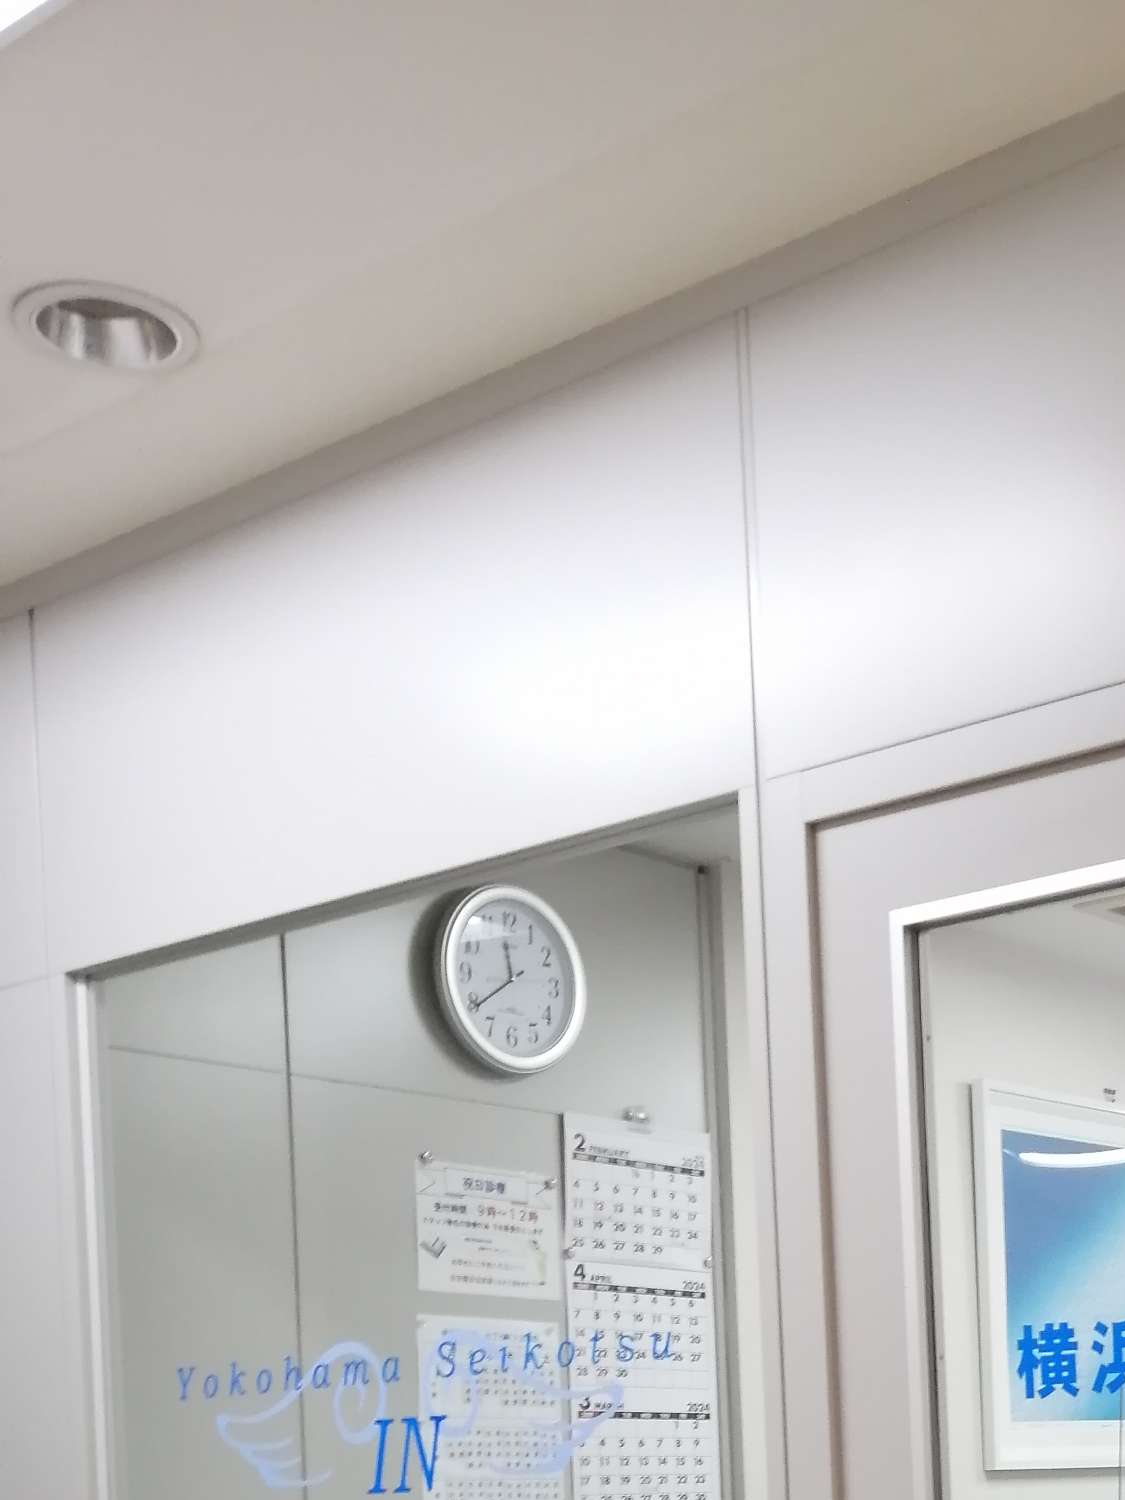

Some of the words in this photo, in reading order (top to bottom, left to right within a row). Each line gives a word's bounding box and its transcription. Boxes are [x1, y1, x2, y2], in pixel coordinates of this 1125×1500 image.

[502, 911, 517, 933] 12
[541, 946, 551, 967] 2
[459, 961, 472, 984] 9
[549, 977, 559, 999] 3
[485, 1016, 495, 1037] 7
[506, 1025, 518, 1048] 6
[528, 1023, 538, 1043] 5
[574, 1133, 586, 1152] 2
[574, 1264, 586, 1281] 4
[176, 1355, 400, 1400] Yokohama
[436, 1331, 674, 1378] Seikotsu
[368, 1414, 447, 1495] IN
